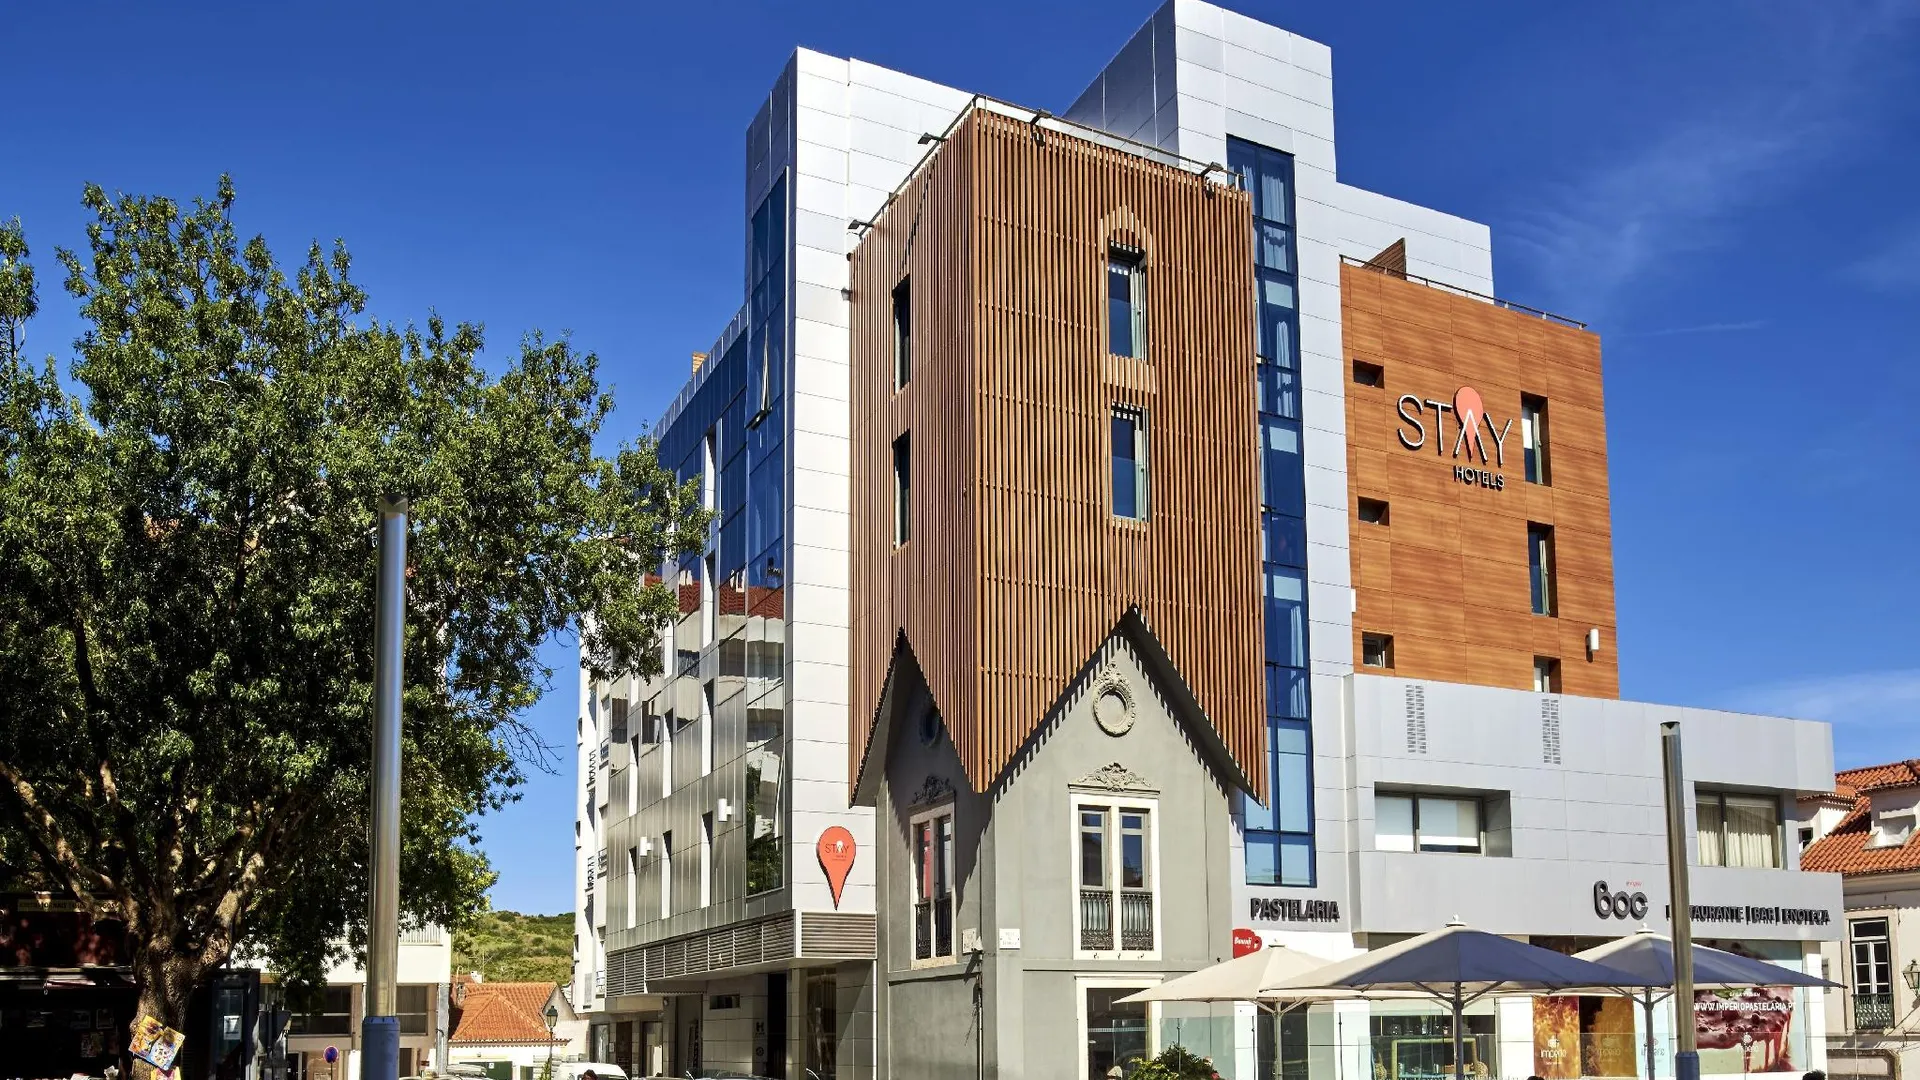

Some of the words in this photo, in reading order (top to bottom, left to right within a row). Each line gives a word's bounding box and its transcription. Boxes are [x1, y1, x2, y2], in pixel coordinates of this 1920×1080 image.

[1397, 392, 1513, 468] STAY
[1453, 465, 1505, 490] HOTELS
[825, 843, 849, 854] STAY
[1251, 898, 1340, 922] PASTELARIA
[1782, 908, 1830, 925] ENOTECA
